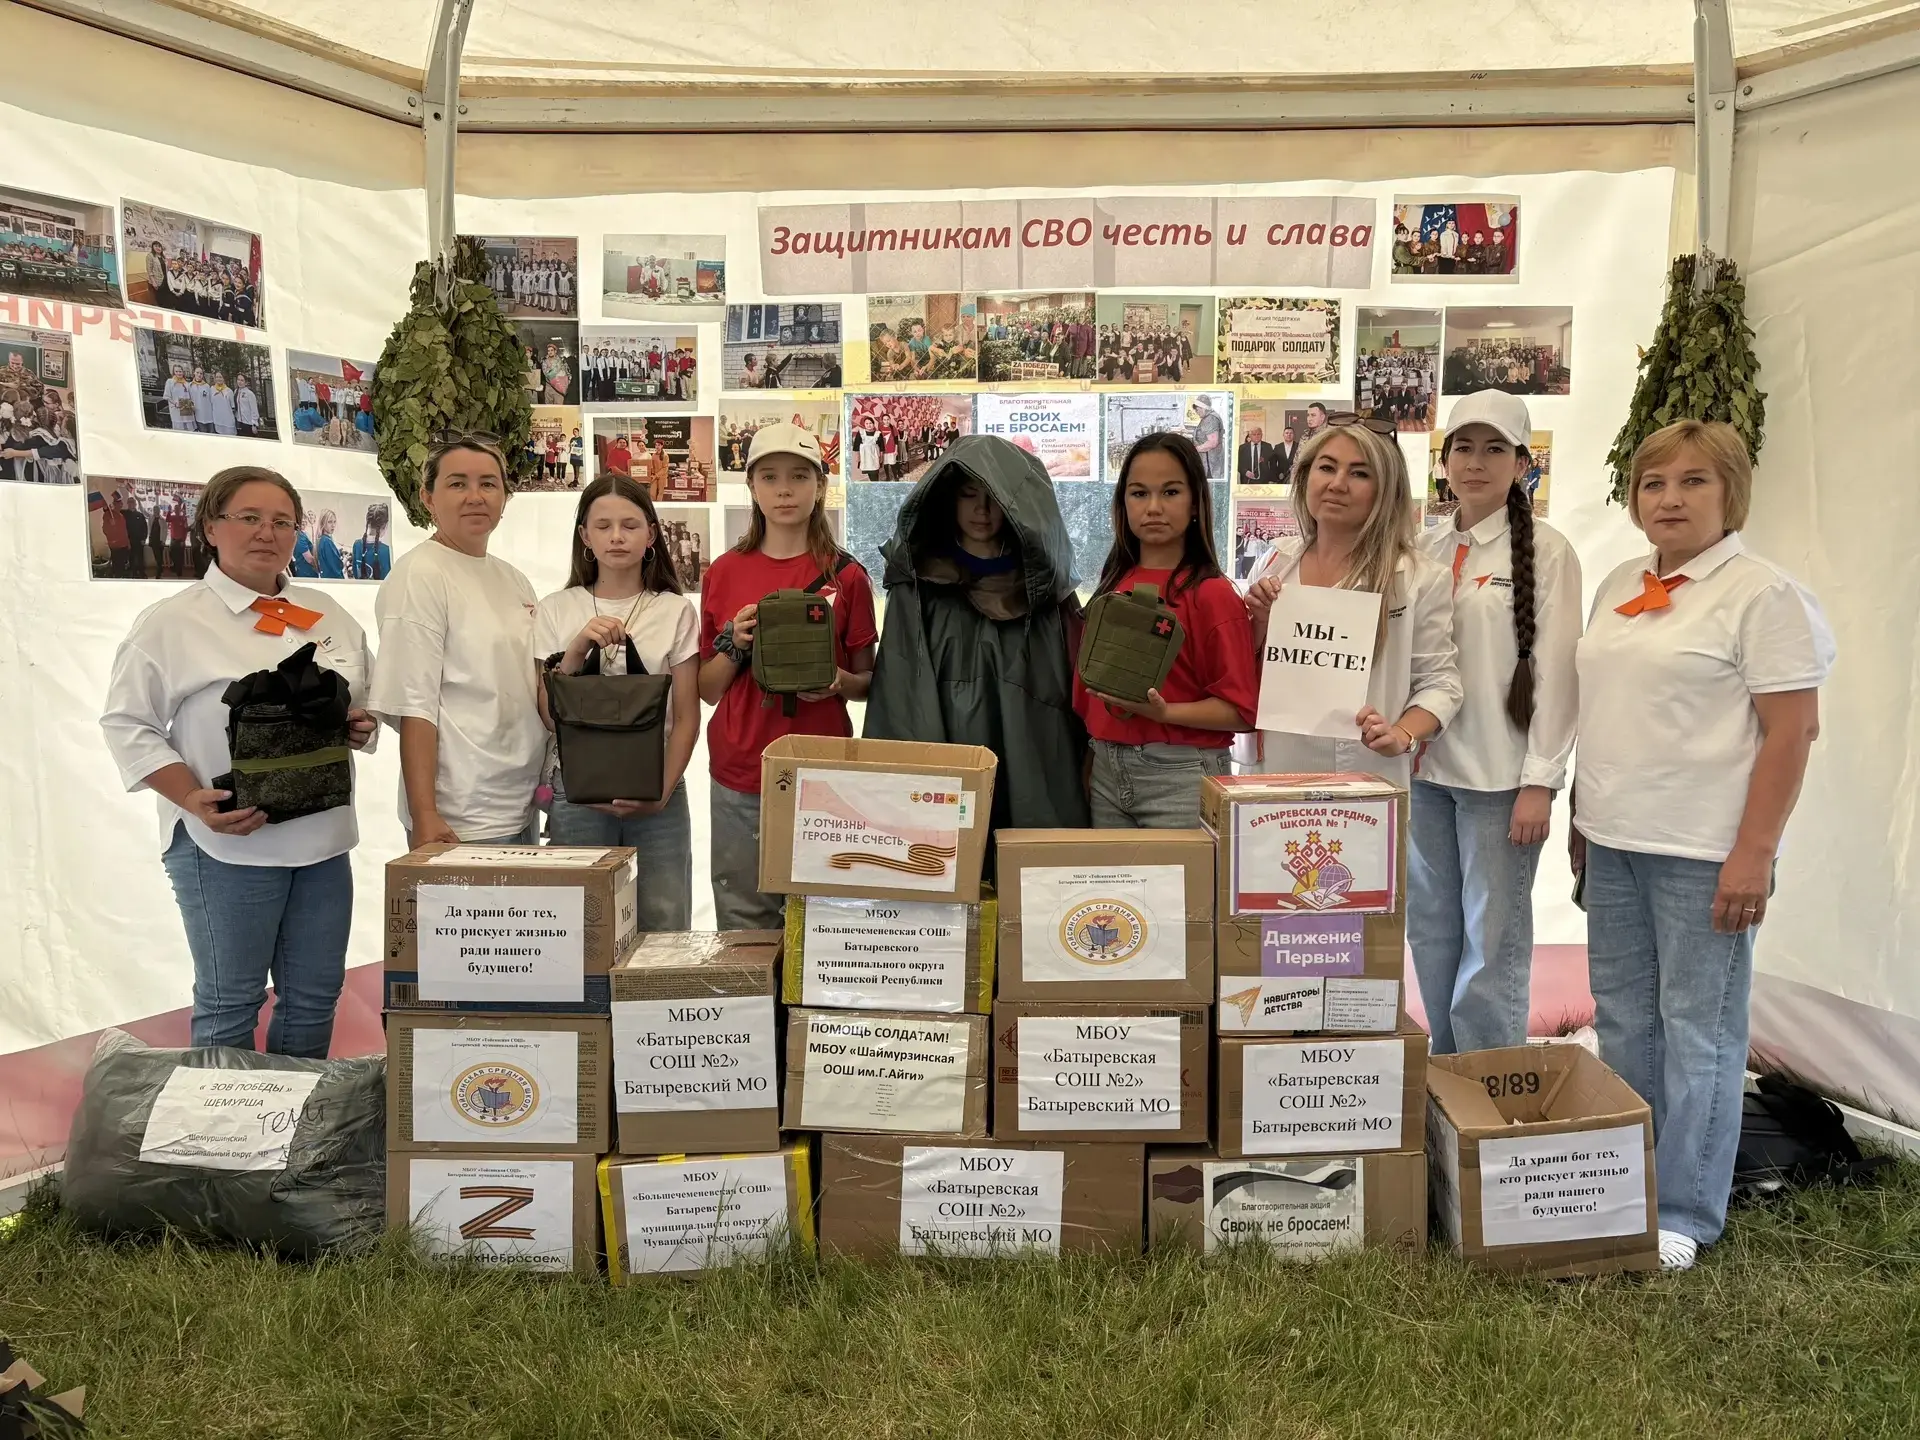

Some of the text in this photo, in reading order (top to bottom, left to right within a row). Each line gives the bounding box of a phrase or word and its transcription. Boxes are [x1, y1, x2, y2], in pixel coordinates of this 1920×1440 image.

[771, 217, 1372, 258] Защитникам СВО честь и слава
[1231, 340, 1326, 353] ПОДАРОК СОЛДАТУ
[1023, 362, 1050, 370] ПОБЕДУ
[1009, 412, 1061, 422] СВОИХ
[985, 423, 1086, 433] НЕ БРОСАЕМ!
[1293, 622, 1335, 641] МЫ
[1266, 646, 1366, 671] ВМЕСТЕ!
[803, 817, 866, 830] У ОТЧИЗНЫ
[1250, 808, 1378, 828] БАТЫРЕВСКАЯ СРЕДНЯЯ
[1280, 819, 1348, 830] ШКОЛА № 1
[802, 831, 842, 842] ГЕРОЕВ
[845, 832, 859, 843] НЕ
[445, 906, 557, 920] Да храни бог тех,
[865, 909, 901, 919] МБОУ
[435, 927, 567, 939] кто рискует жизнью
[812, 925, 951, 937] «Большечеменевская СОШ»
[1066, 904, 1139, 950] ТОЙСИНСКАЯ СРЕДНЯЯ ШКОЛА
[1264, 930, 1361, 947] Движение
[460, 947, 541, 958] ради нашего
[844, 942, 919, 953] Батыревского
[817, 959, 945, 971] муниципального округа
[1276, 950, 1350, 967] Первых
[468, 962, 533, 975] будущего!
[818, 973, 943, 986] Чувашской Республики
[1264, 988, 1320, 1005] НАВИГАТОРЫ
[668, 1007, 724, 1022] МБОУ
[1264, 1001, 1303, 1016] ДЕТСТВА
[811, 1023, 950, 1043] ПОМОЩЬ СОЛДАТАМ!
[1076, 1025, 1131, 1040] МБОУ
[636, 1032, 750, 1049] «Батыревская
[809, 1043, 955, 1064] МБОУ «Шаймурзинская
[1043, 1049, 1156, 1067] «Батыревская
[1301, 1049, 1356, 1064] МБОУ
[650, 1054, 739, 1069] СОШ №2»
[823, 1064, 924, 1081] ООШ им.Г.Айги»
[1055, 1072, 1144, 1088] СОШ №2»
[211, 1082, 284, 1093] ЗОВ ПОБЕДЫ
[624, 1077, 767, 1097] Батыревский МО
[1268, 1073, 1380, 1090] «Батыревская
[1481, 1071, 1540, 1098] 8/89
[458, 1067, 532, 1112] ТОЙСИНСКАЯ СРЕДНЯЯ ШКОЛА
[204, 1098, 264, 1108] ШЕМУРША
[1028, 1096, 1134, 1115] Батыревский
[1140, 1098, 1170, 1113] МО
[1279, 1094, 1366, 1109] СОШ №2»
[1252, 1116, 1392, 1136] Батыревский МО
[188, 1134, 248, 1143] Шемуршинский
[231, 1151, 252, 1159] округ
[257, 1150, 269, 1158] ЧР
[1509, 1149, 1620, 1168] Да храни бог тех,
[959, 1157, 1015, 1172] МБОУ
[683, 1172, 719, 1183] МБОУ
[1499, 1166, 1629, 1185] кто рискует жизнью
[632, 1184, 772, 1202] «Большечеменевская СОШ»
[927, 1180, 1038, 1198] «Батыревская
[1524, 1186, 1605, 1202] ради нашего
[666, 1203, 741, 1216] Батыревского
[938, 1202, 1026, 1218] СОШ №2»
[1242, 1203, 1308, 1212] Благотворительная
[1532, 1201, 1598, 1218] будущего!
[641, 1217, 769, 1235] муниципального округа
[1220, 1215, 1350, 1235] Своих не бросаем!
[643, 1232, 769, 1248] Чувашской Республики
[911, 1226, 1052, 1244] Батыревский МО
[1304, 1241, 1331, 1249] помощи
